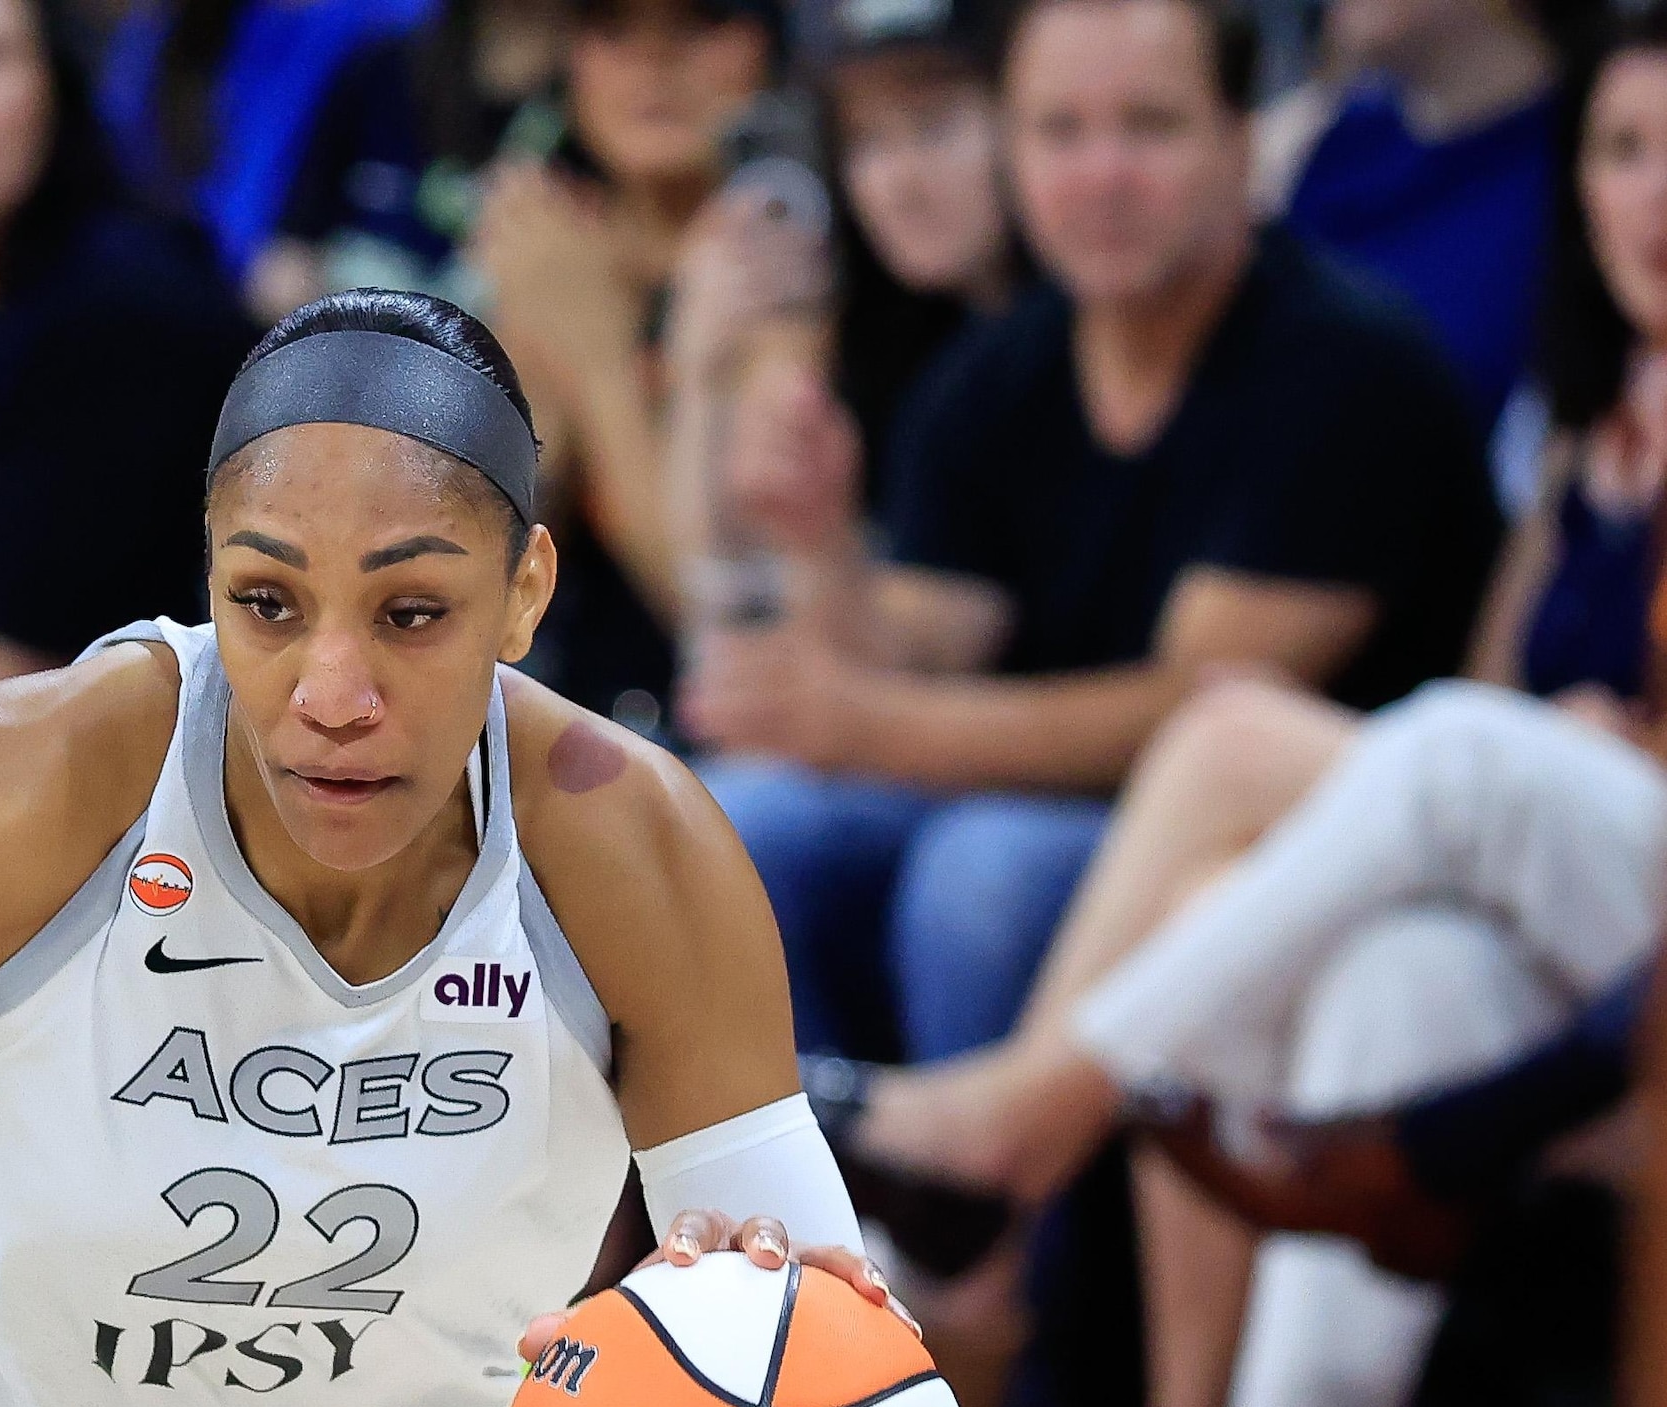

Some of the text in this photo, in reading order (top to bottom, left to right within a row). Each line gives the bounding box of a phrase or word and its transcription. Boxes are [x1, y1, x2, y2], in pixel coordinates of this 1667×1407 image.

[434, 963, 531, 1018] ally
[111, 1027, 513, 1145] ACES
[126, 1167, 419, 1315] 22
[93, 1317, 381, 1393] IPSY
